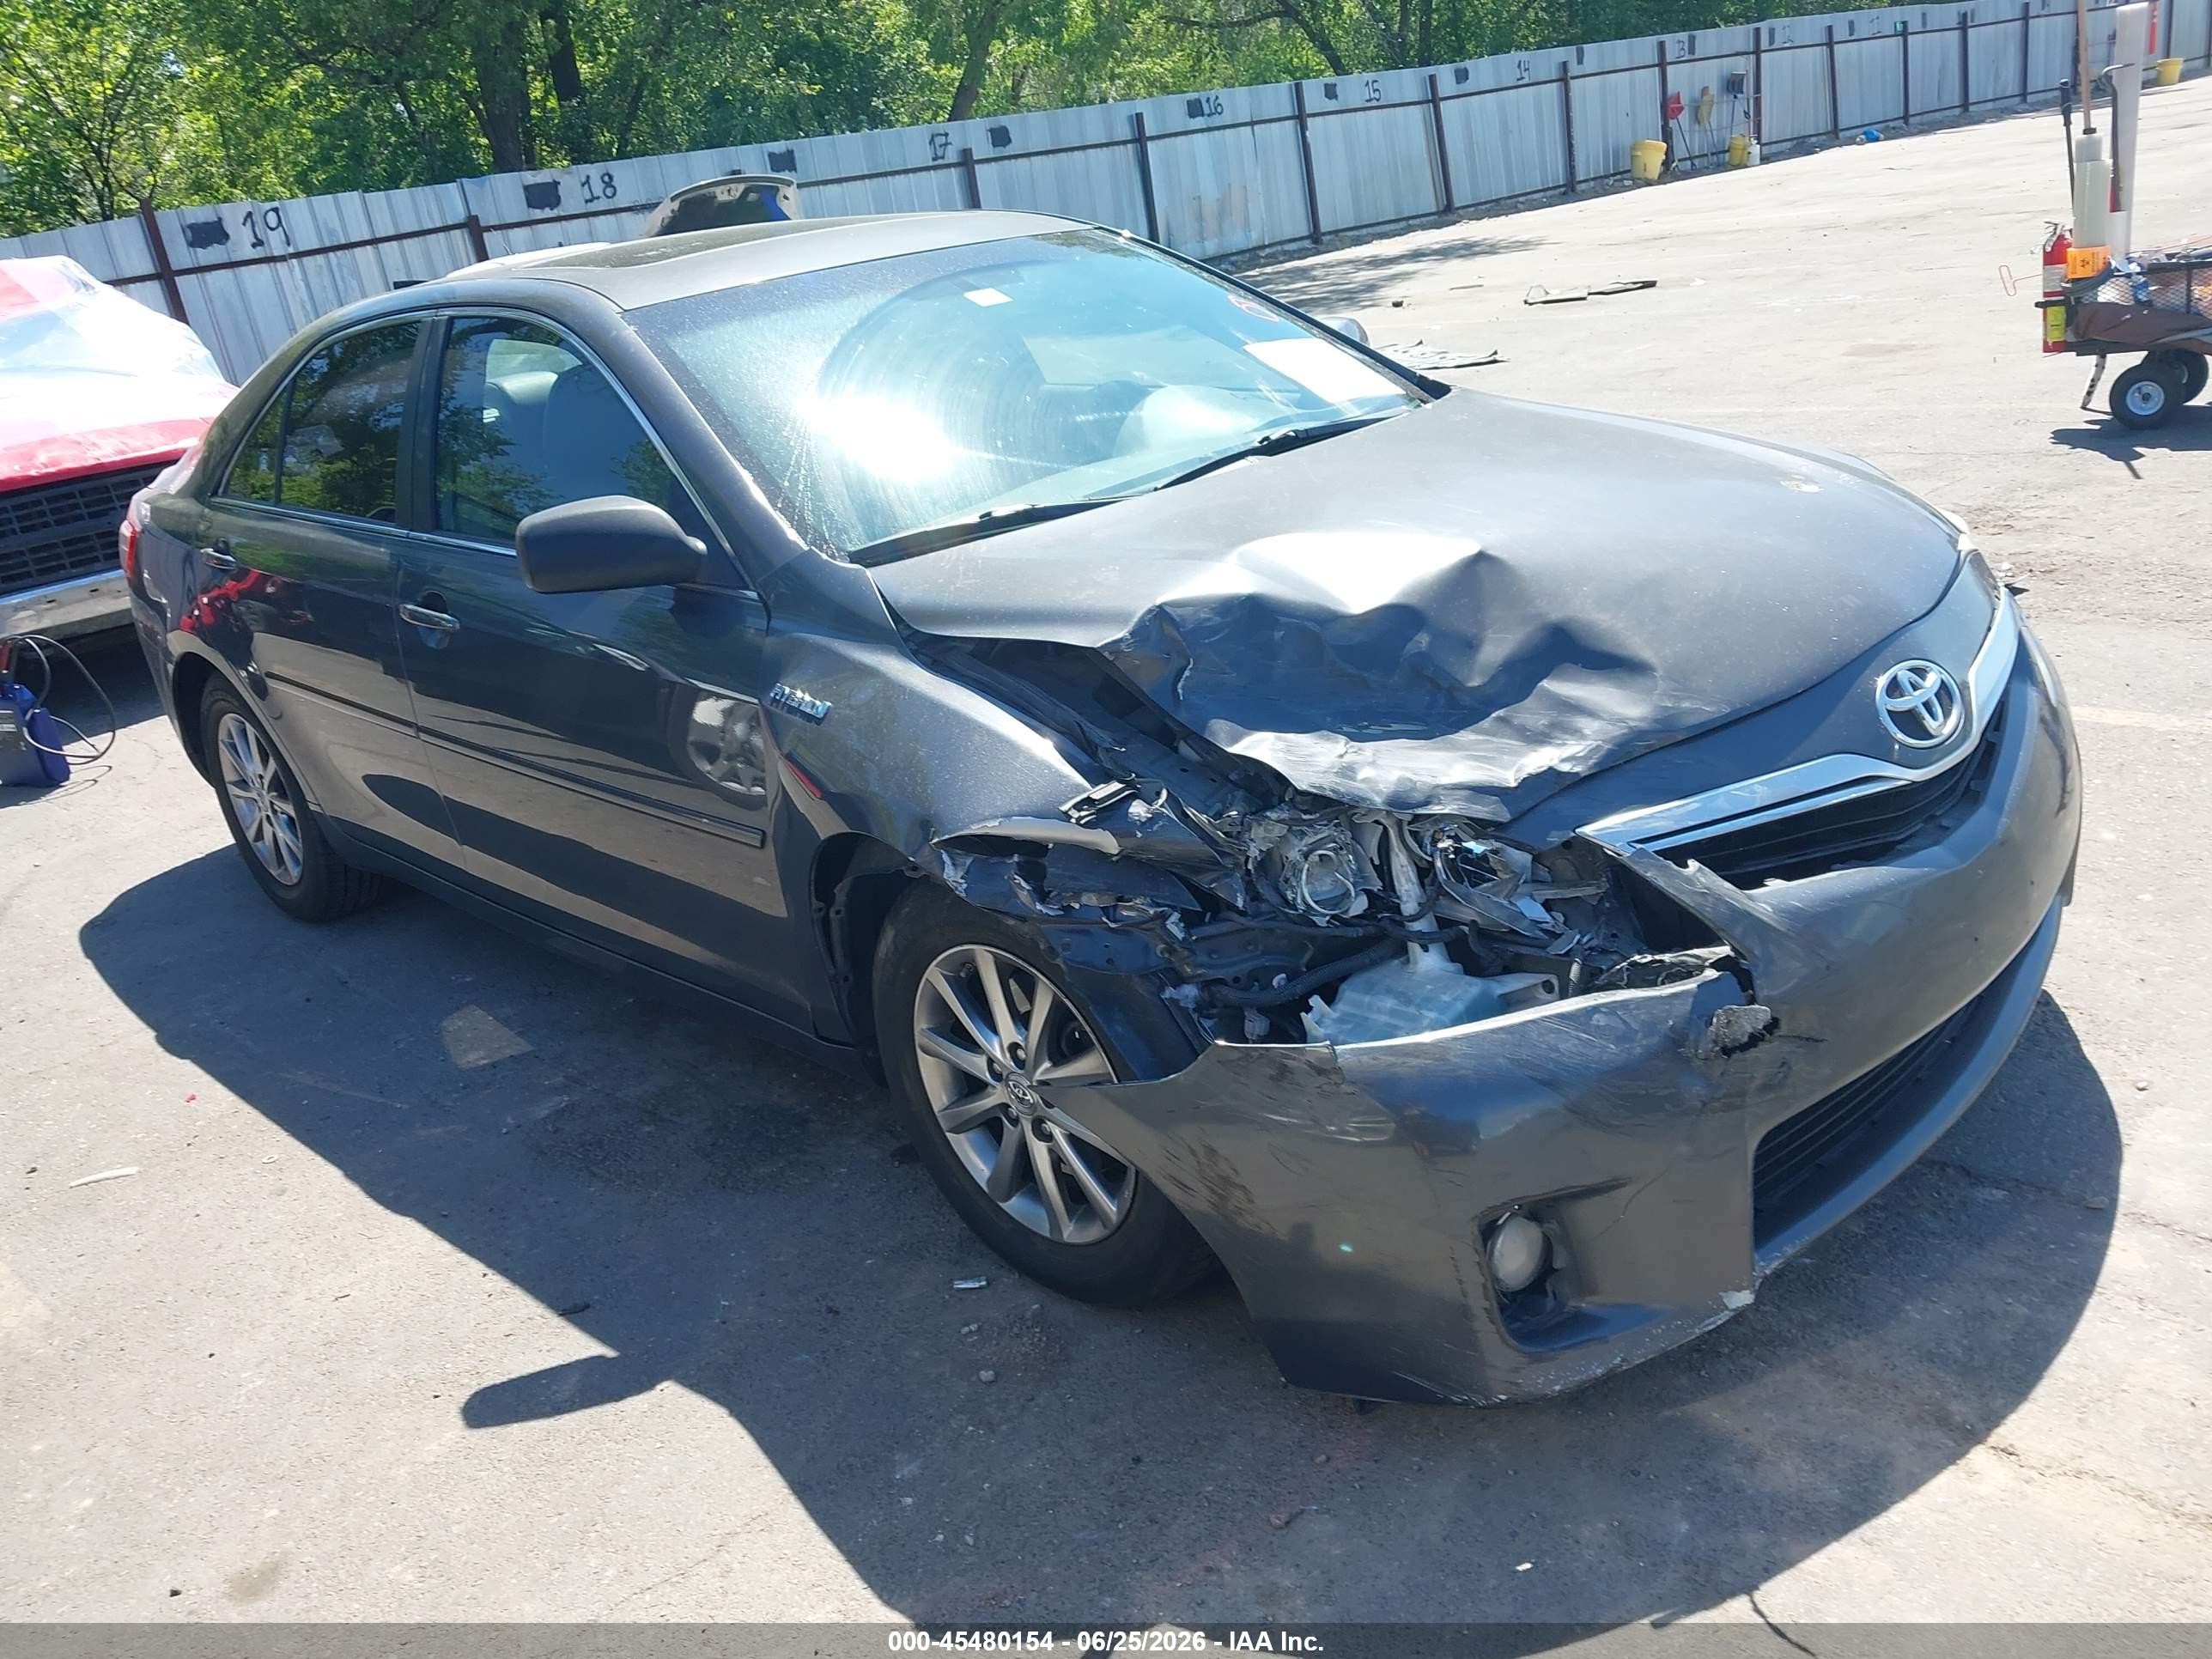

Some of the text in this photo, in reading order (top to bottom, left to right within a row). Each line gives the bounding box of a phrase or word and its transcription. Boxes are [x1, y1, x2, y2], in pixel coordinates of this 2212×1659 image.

[1516, 59, 1531, 82] 14
[1364, 79, 1382, 103] 15
[1205, 94, 1224, 118] 16
[928, 131, 953, 162] 17
[581, 172, 617, 204] 18
[241, 206, 291, 249] 19
